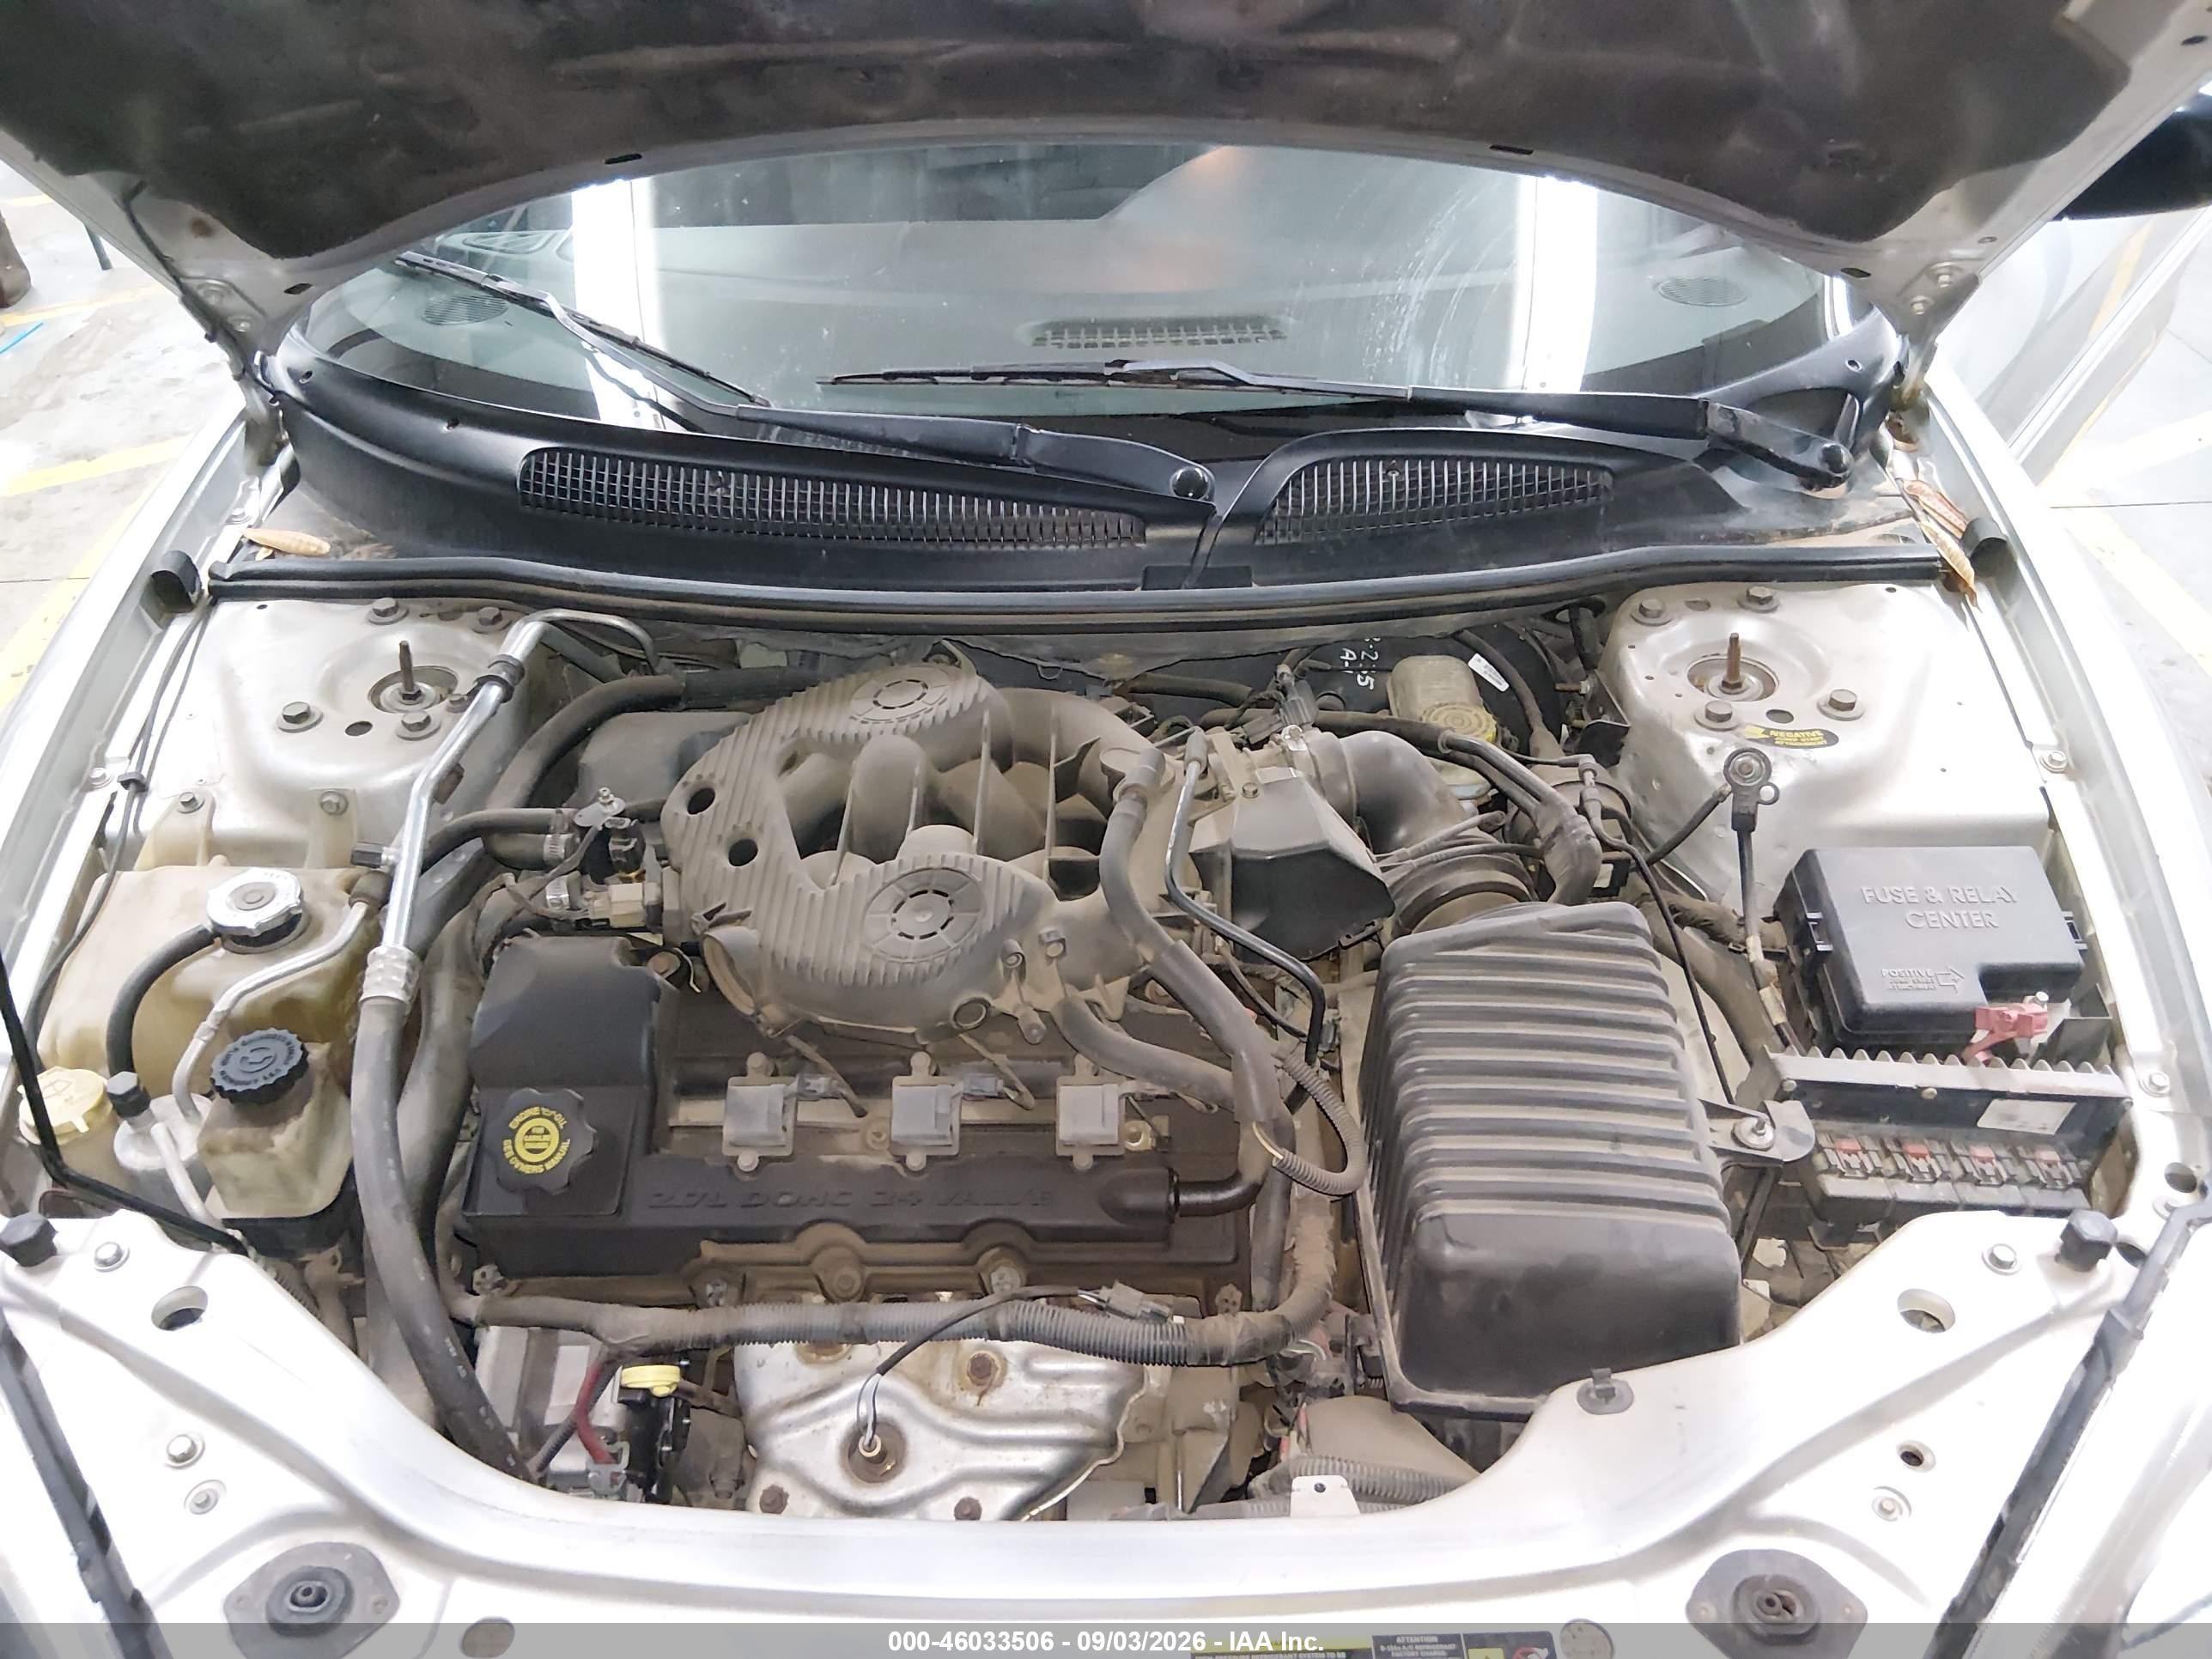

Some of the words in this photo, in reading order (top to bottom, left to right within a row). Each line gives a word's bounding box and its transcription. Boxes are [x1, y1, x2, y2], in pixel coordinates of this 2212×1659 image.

[1769, 730, 1824, 738] NEGATIVE
[1862, 886, 1919, 903] FUSE
[1923, 886, 1944, 904] &
[1948, 886, 2016, 903] RELAY
[1905, 911, 1999, 928] CENTER
[1881, 968, 1935, 978] POSITIVE
[554, 1113, 568, 1129] OIL
[739, 1190, 854, 1207] DOHC
